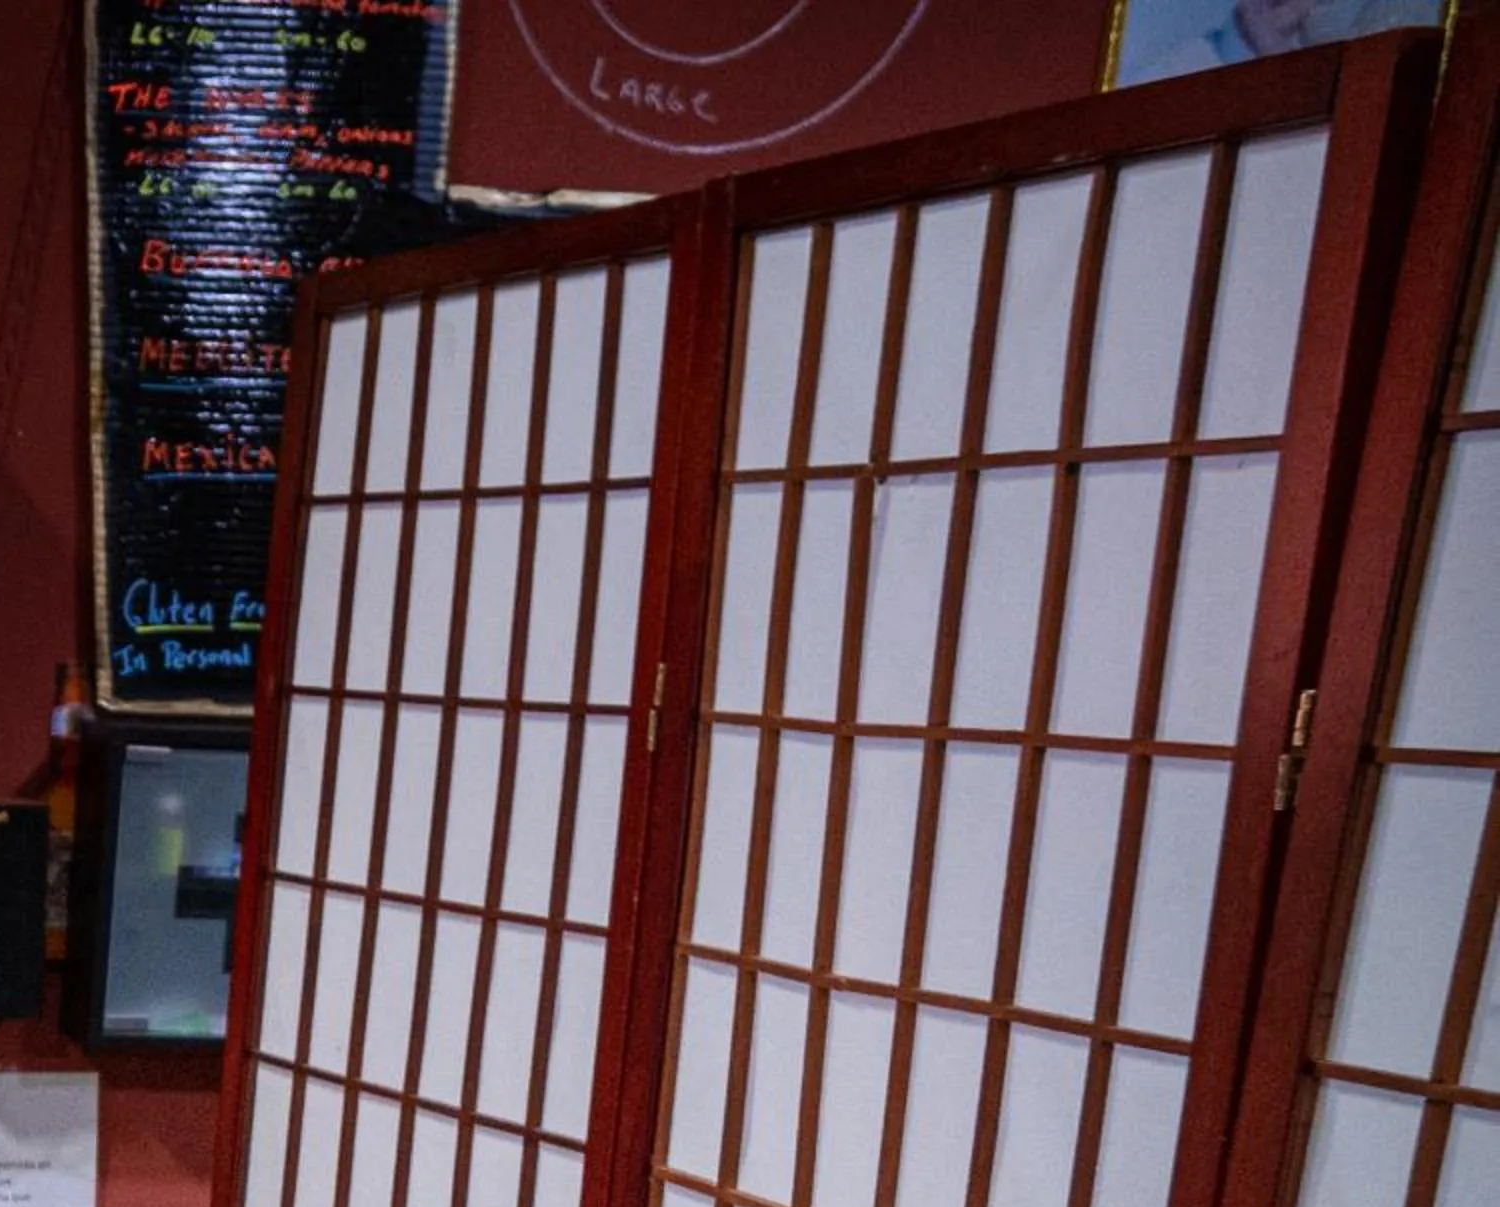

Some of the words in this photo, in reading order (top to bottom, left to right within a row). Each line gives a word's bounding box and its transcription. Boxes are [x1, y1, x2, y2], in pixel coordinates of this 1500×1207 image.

[107, 81, 172, 112] THE
[112, 643, 148, 676] In
[160, 639, 253, 672] Personal
